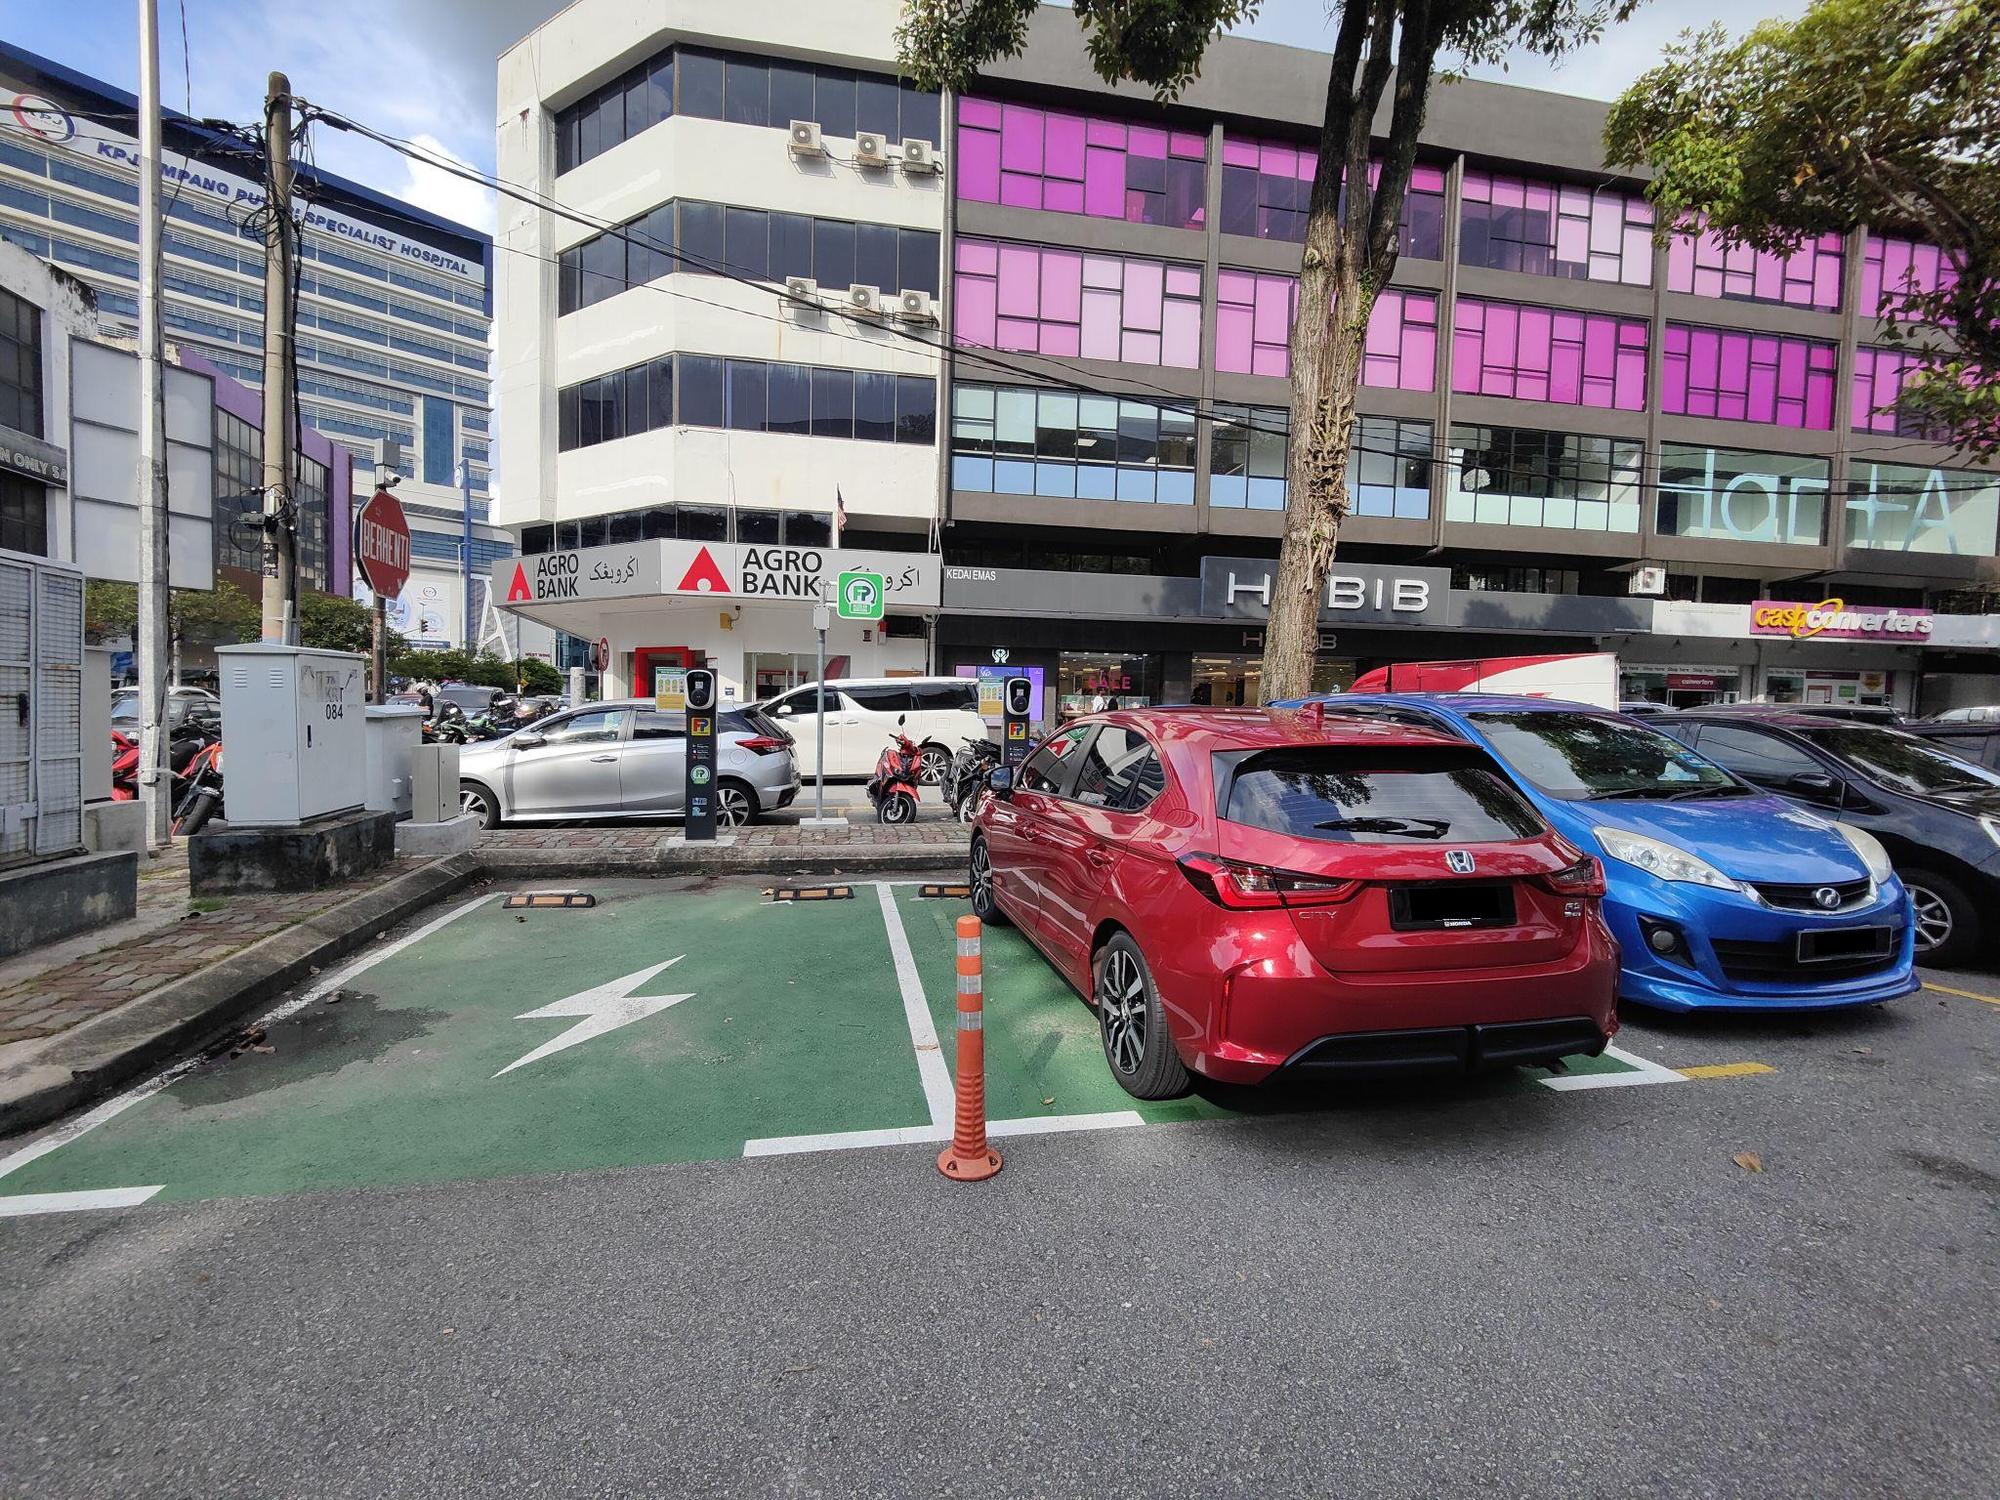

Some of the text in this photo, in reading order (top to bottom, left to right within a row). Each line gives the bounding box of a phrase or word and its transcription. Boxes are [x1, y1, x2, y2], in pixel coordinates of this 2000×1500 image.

[97, 142, 139, 167] KPJ
[161, 163, 229, 196] MPANG
[304, 211, 397, 251] SPECIALIST
[401, 243, 468, 275] HOSPITAL
[14, 452, 48, 475] ONLY
[363, 518, 411, 572] BERHENTI
[537, 553, 579, 577] AGRO
[742, 548, 823, 573] AGRO
[742, 572, 821, 597] BANK
[946, 568, 997, 581] KEDAI EMAS
[537, 576, 579, 599] BANK
[1227, 571, 1431, 613] HBIB
[1806, 609, 1934, 634] converters
[325, 704, 344, 719] 084
[1298, 911, 1337, 919] CITY
